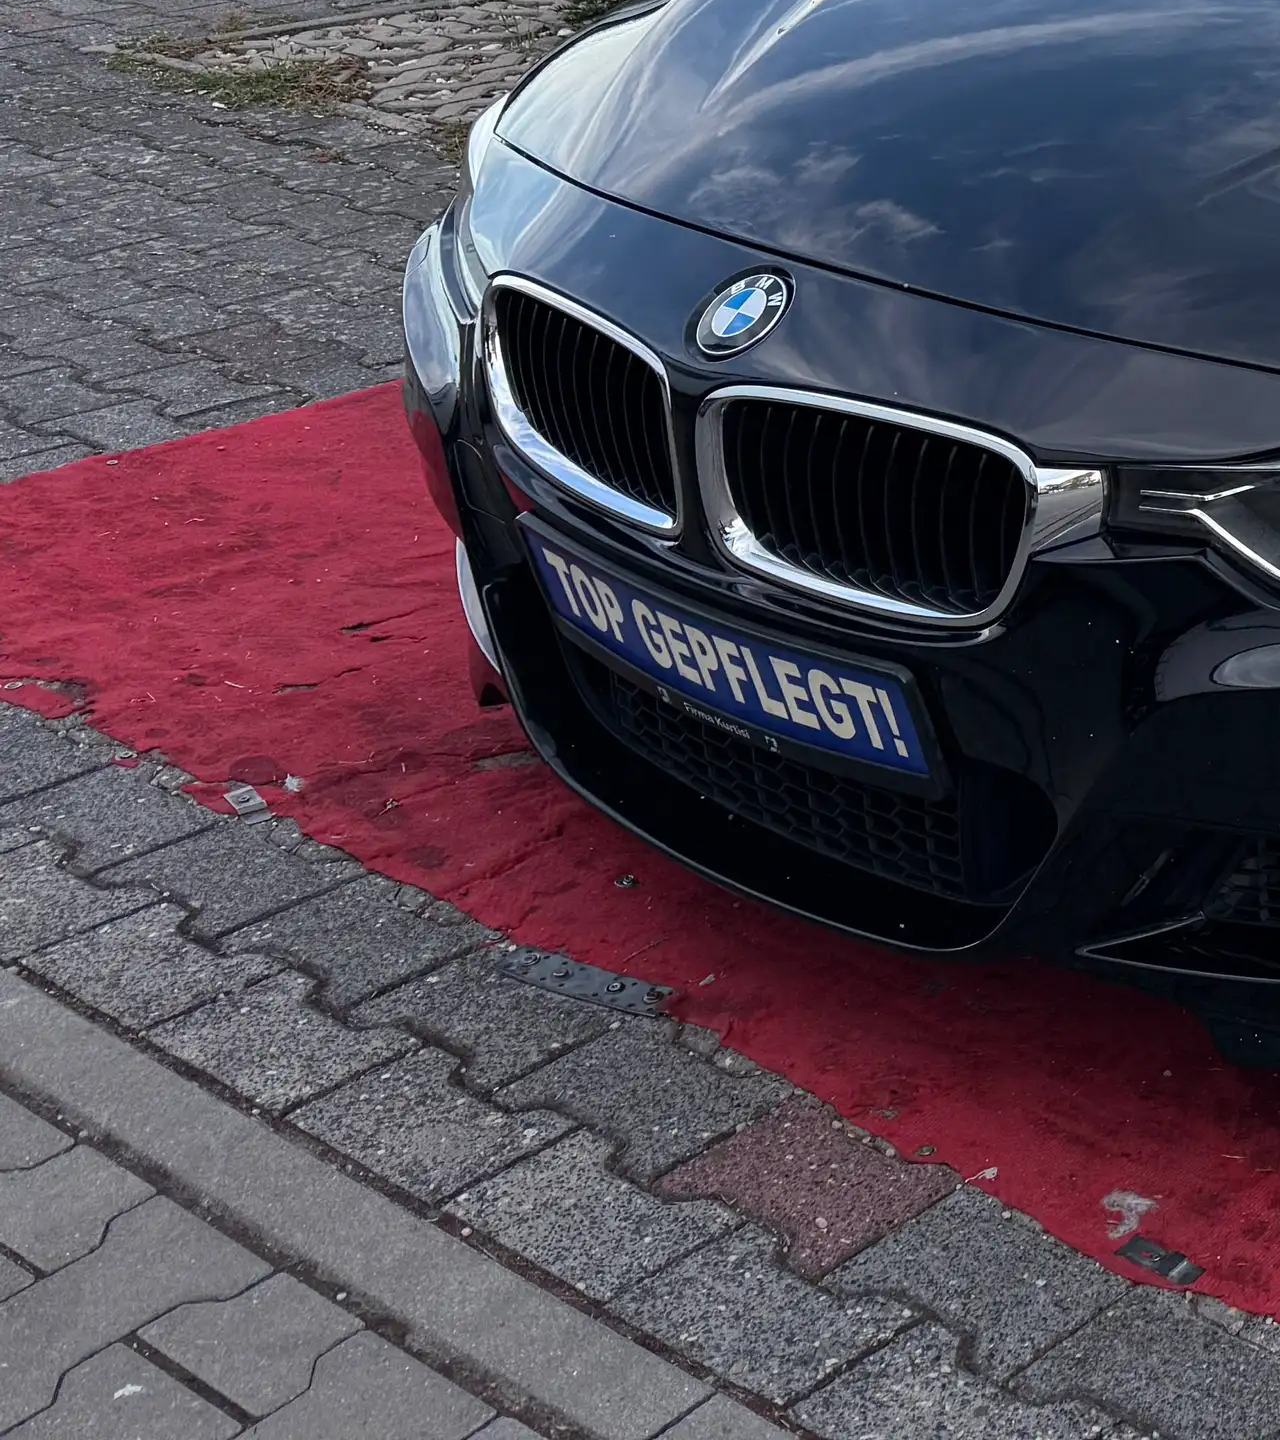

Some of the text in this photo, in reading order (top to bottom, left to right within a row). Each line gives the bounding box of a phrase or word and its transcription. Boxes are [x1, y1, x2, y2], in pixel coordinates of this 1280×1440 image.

[730, 276, 783, 306] BMW
[542, 548, 910, 758] TOP GEPFLEGT!
